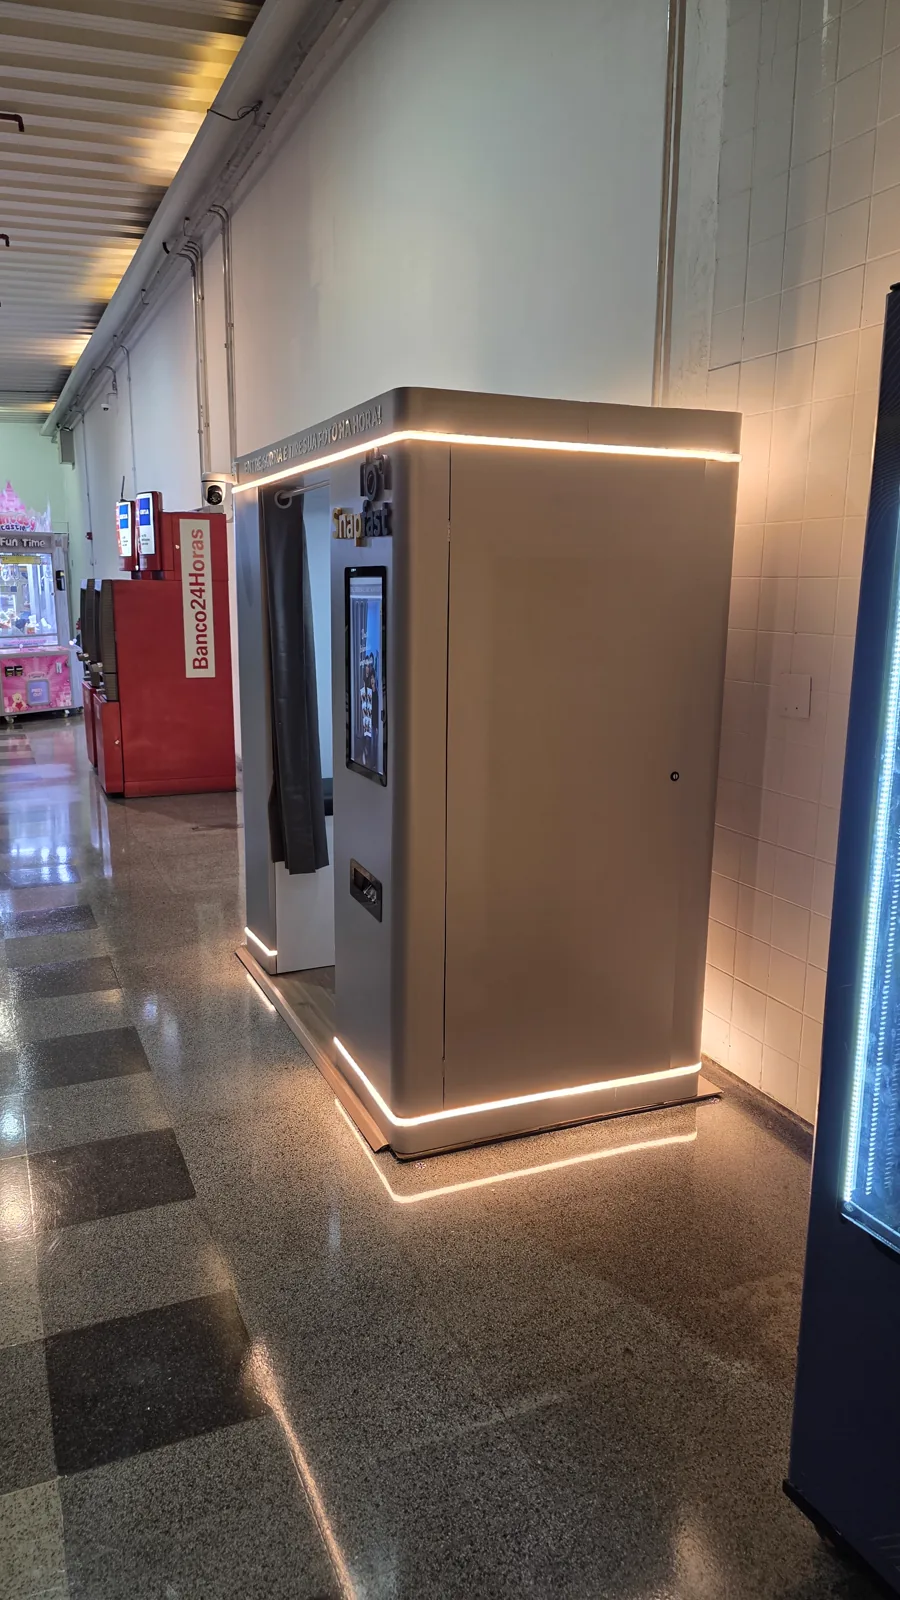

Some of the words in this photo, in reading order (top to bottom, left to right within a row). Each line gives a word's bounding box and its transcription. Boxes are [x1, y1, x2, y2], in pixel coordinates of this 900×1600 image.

[303, 433, 317, 453] SUA
[318, 423, 337, 447] FOTO
[338, 419, 352, 438] NA
[354, 405, 382, 433] HORA!
[0, 536, 18, 547] Fun
[22, 537, 46, 548] Time
[189, 528, 208, 670] Banco24Horas
